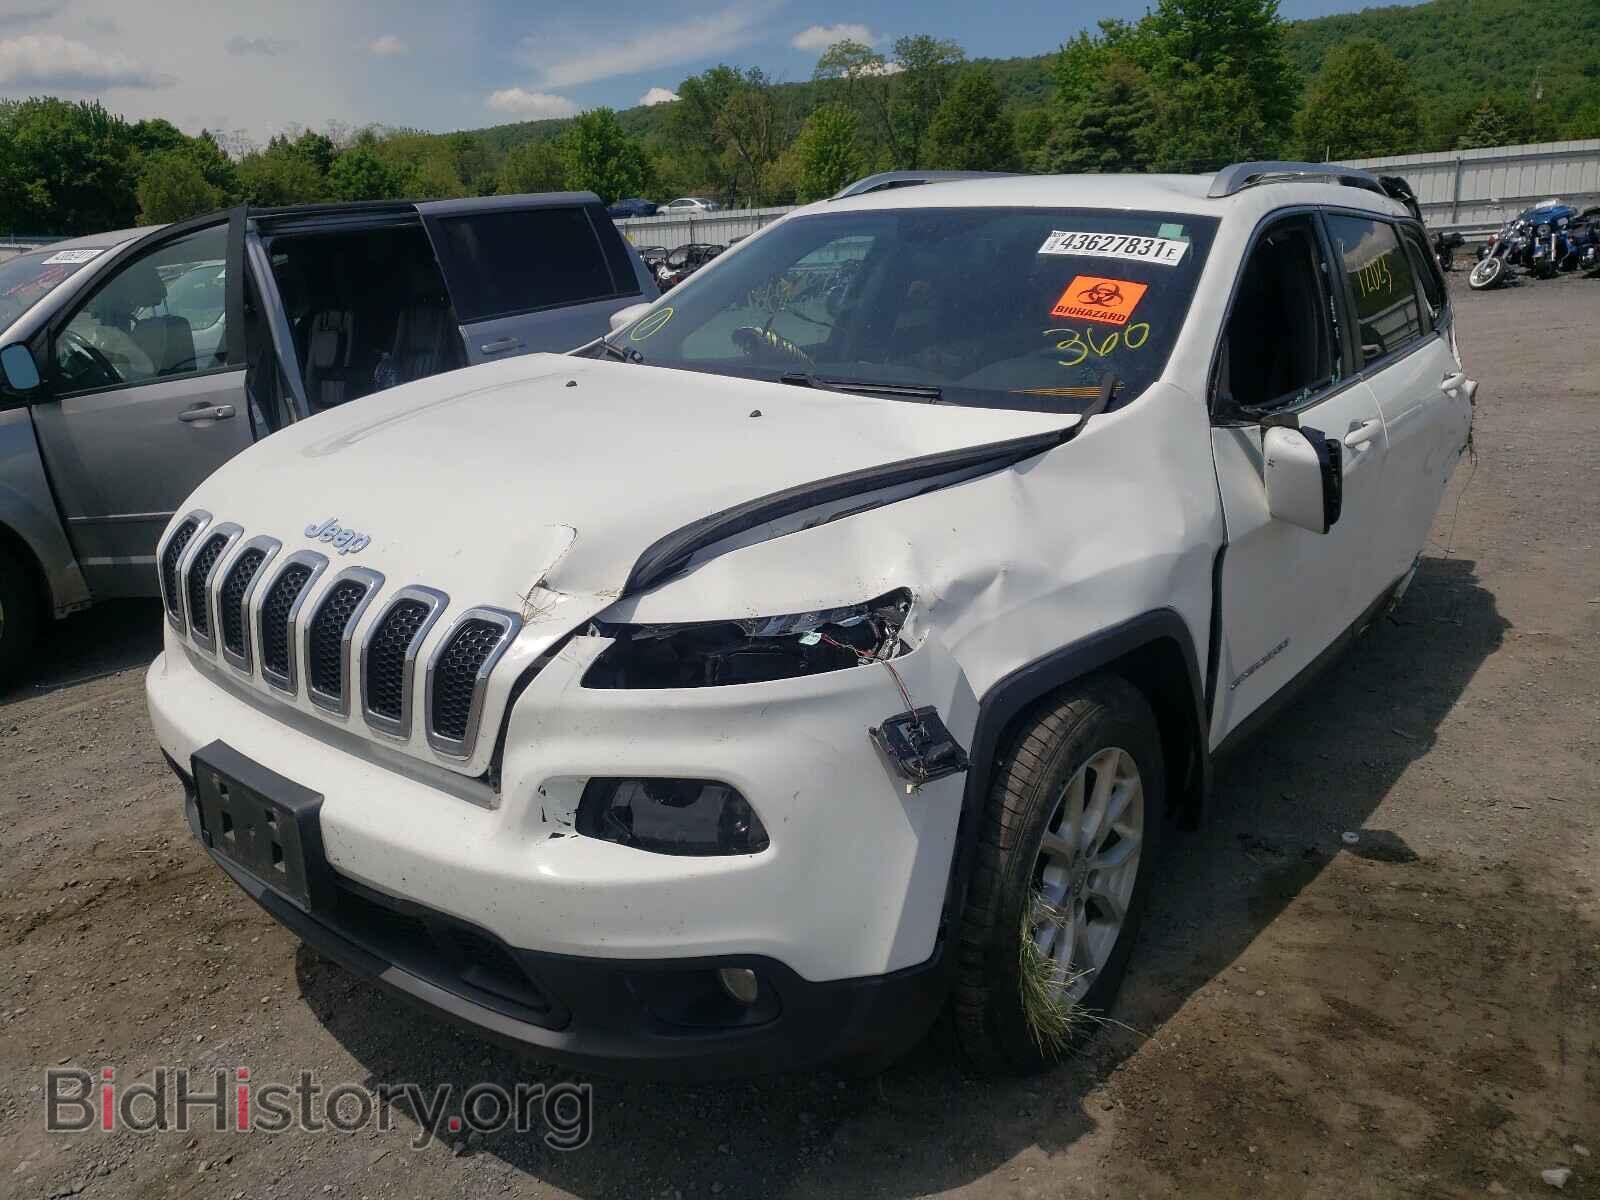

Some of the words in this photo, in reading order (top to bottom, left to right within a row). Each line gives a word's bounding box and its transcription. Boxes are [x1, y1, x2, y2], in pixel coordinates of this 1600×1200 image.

[1060, 233, 1166, 257] 43627831
[1166, 248, 1177, 257] F
[1054, 305, 1127, 323] BIOHAZARD
[1042, 322, 1150, 366] 360
[303, 517, 371, 556] Jeep
